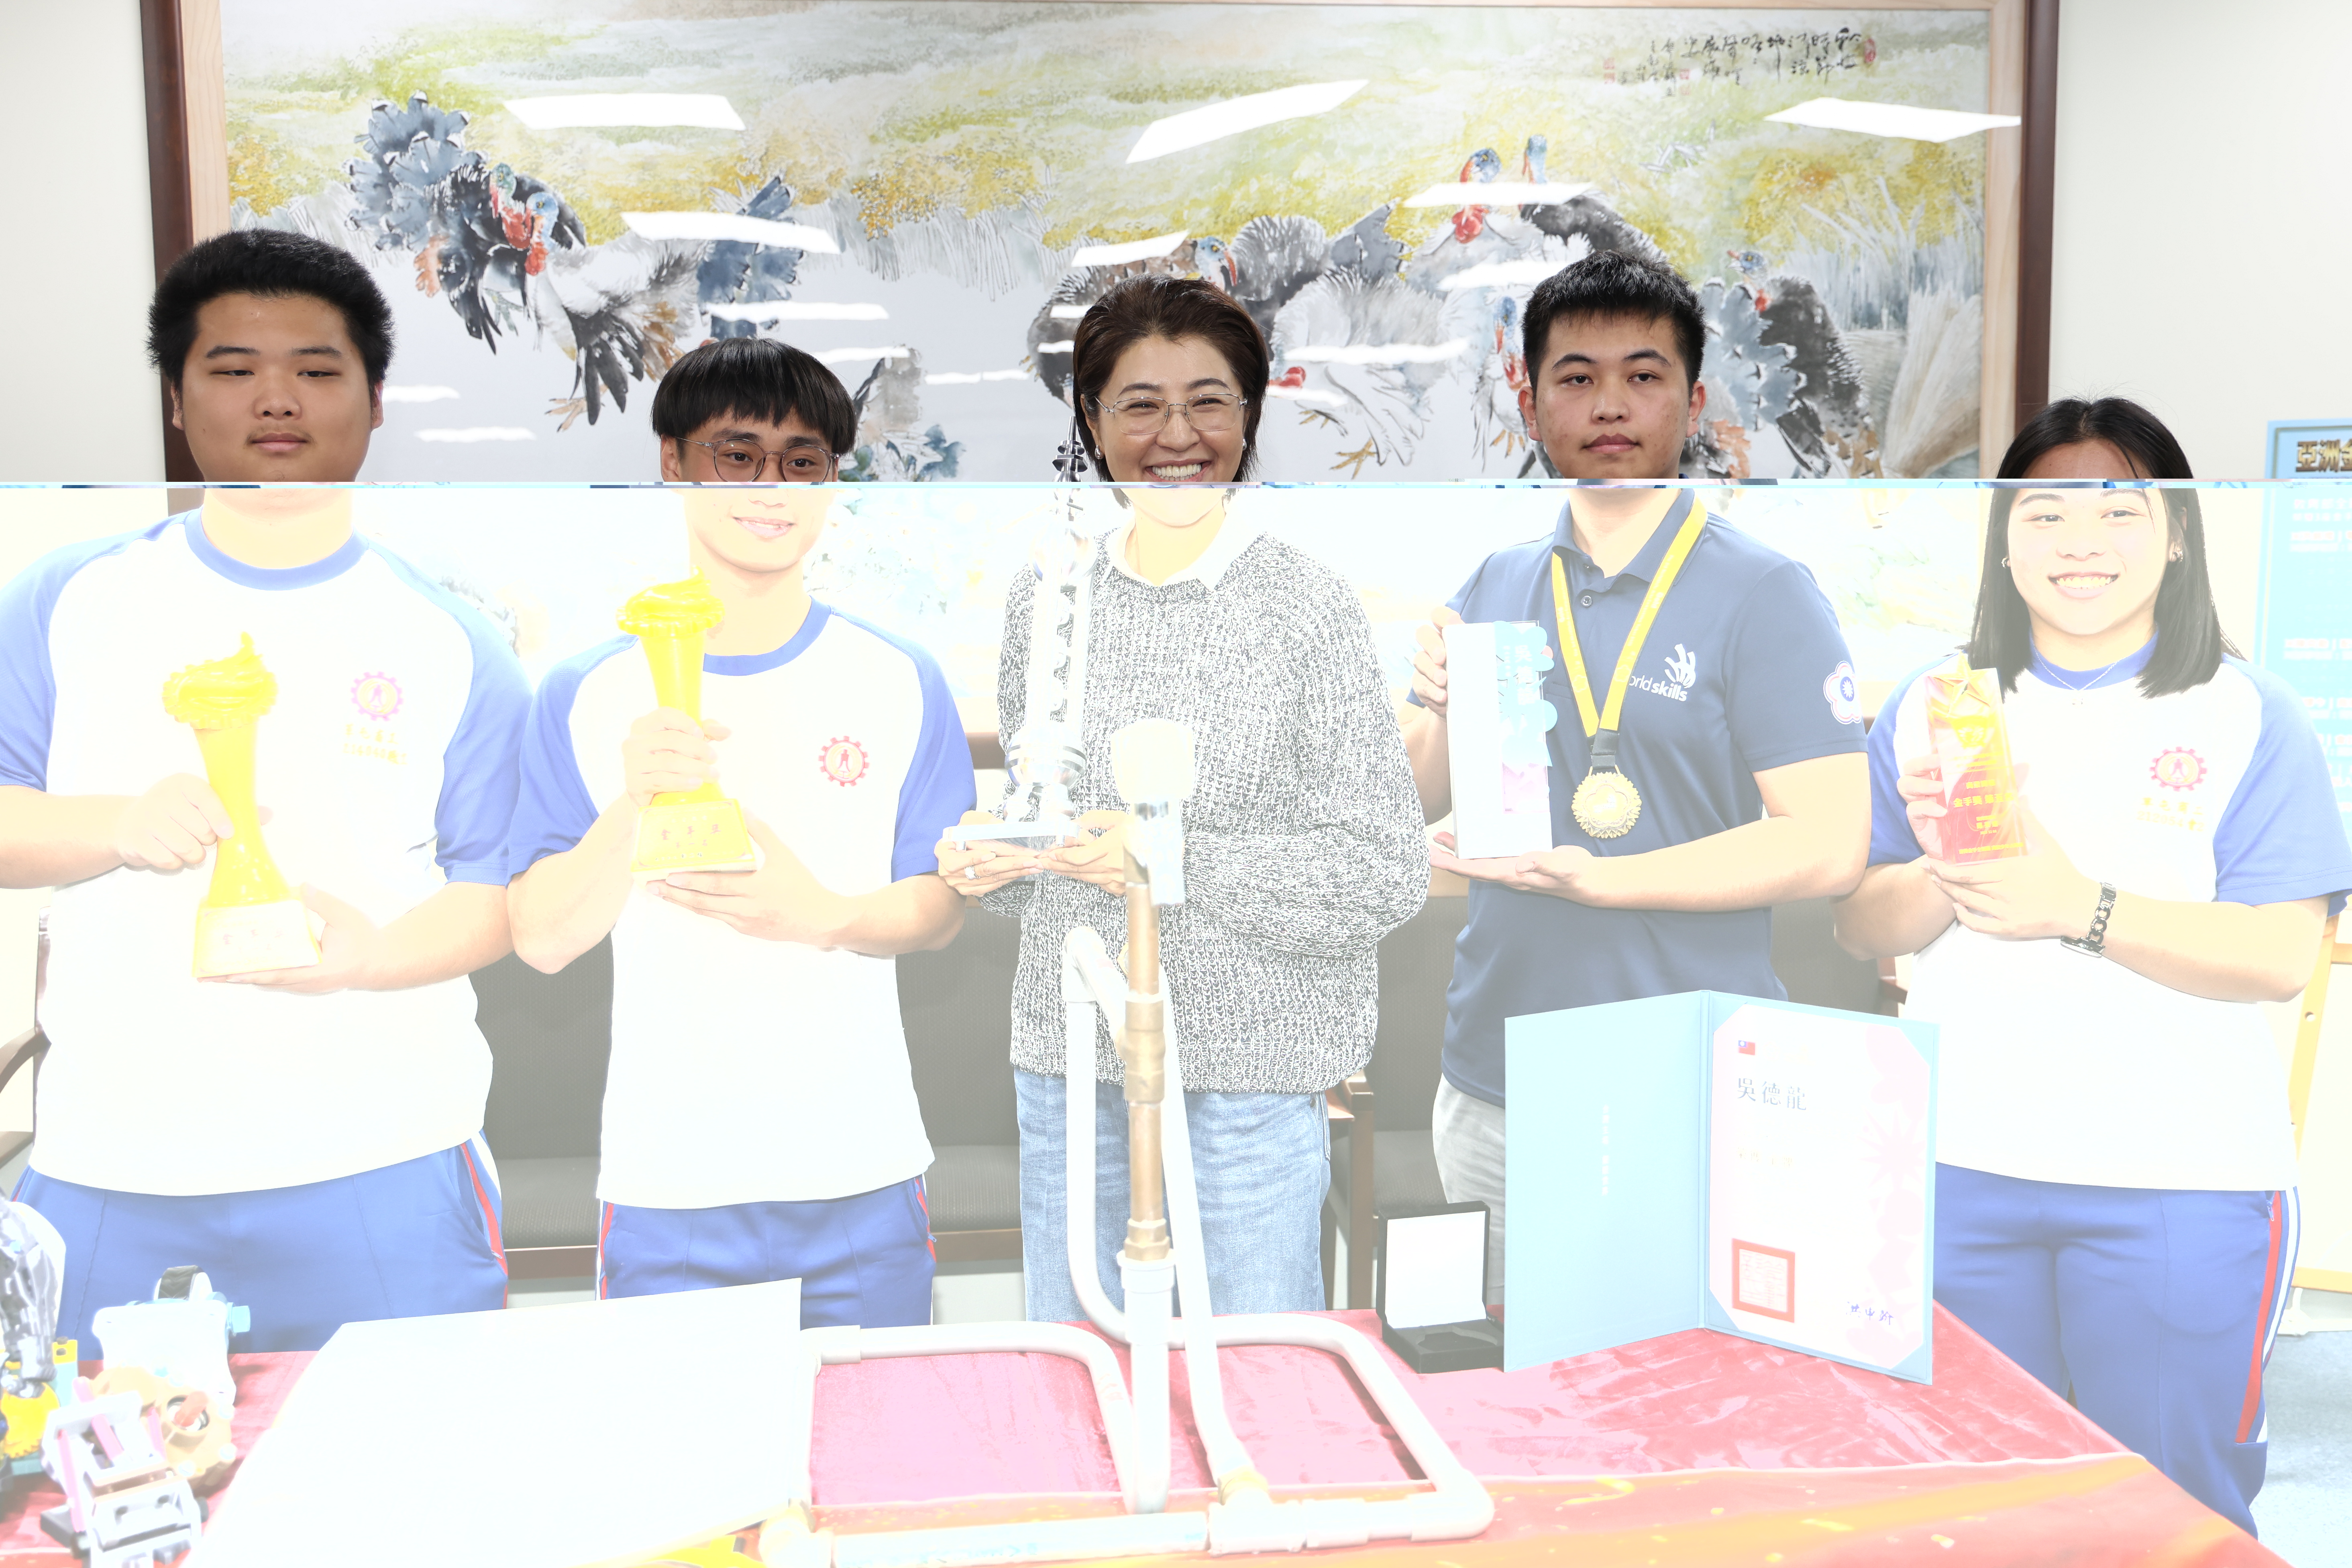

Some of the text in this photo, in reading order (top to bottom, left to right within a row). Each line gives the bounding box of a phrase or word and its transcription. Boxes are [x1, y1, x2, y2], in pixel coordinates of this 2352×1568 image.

[1629, 675, 1688, 701] orldskills
[1737, 1078, 1806, 1110] 吳德龍
